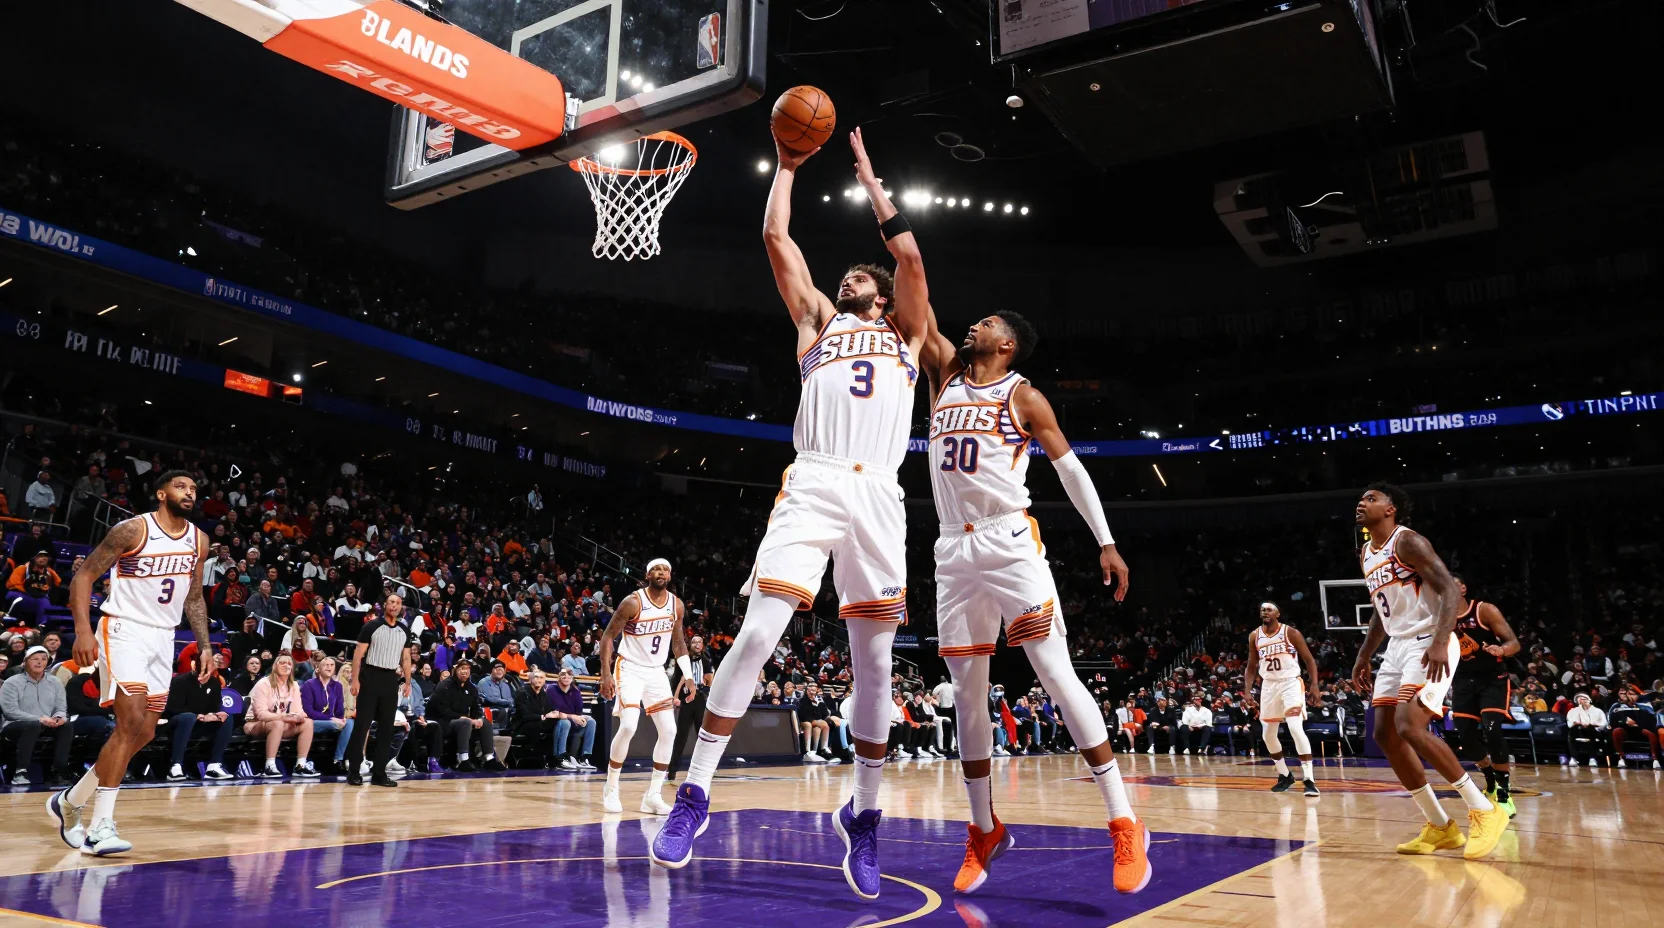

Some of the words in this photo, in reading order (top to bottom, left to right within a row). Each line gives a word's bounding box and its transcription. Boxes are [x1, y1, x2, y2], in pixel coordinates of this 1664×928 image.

[820, 330, 900, 364] SUNS
[849, 360, 875, 399] 3
[930, 405, 999, 439] SUNS
[941, 437, 979, 474] 30
[157, 578, 176, 605] 3
[1376, 591, 1391, 617] 3
[650, 635, 662, 655] 9
[1265, 657, 1282, 672] 20
